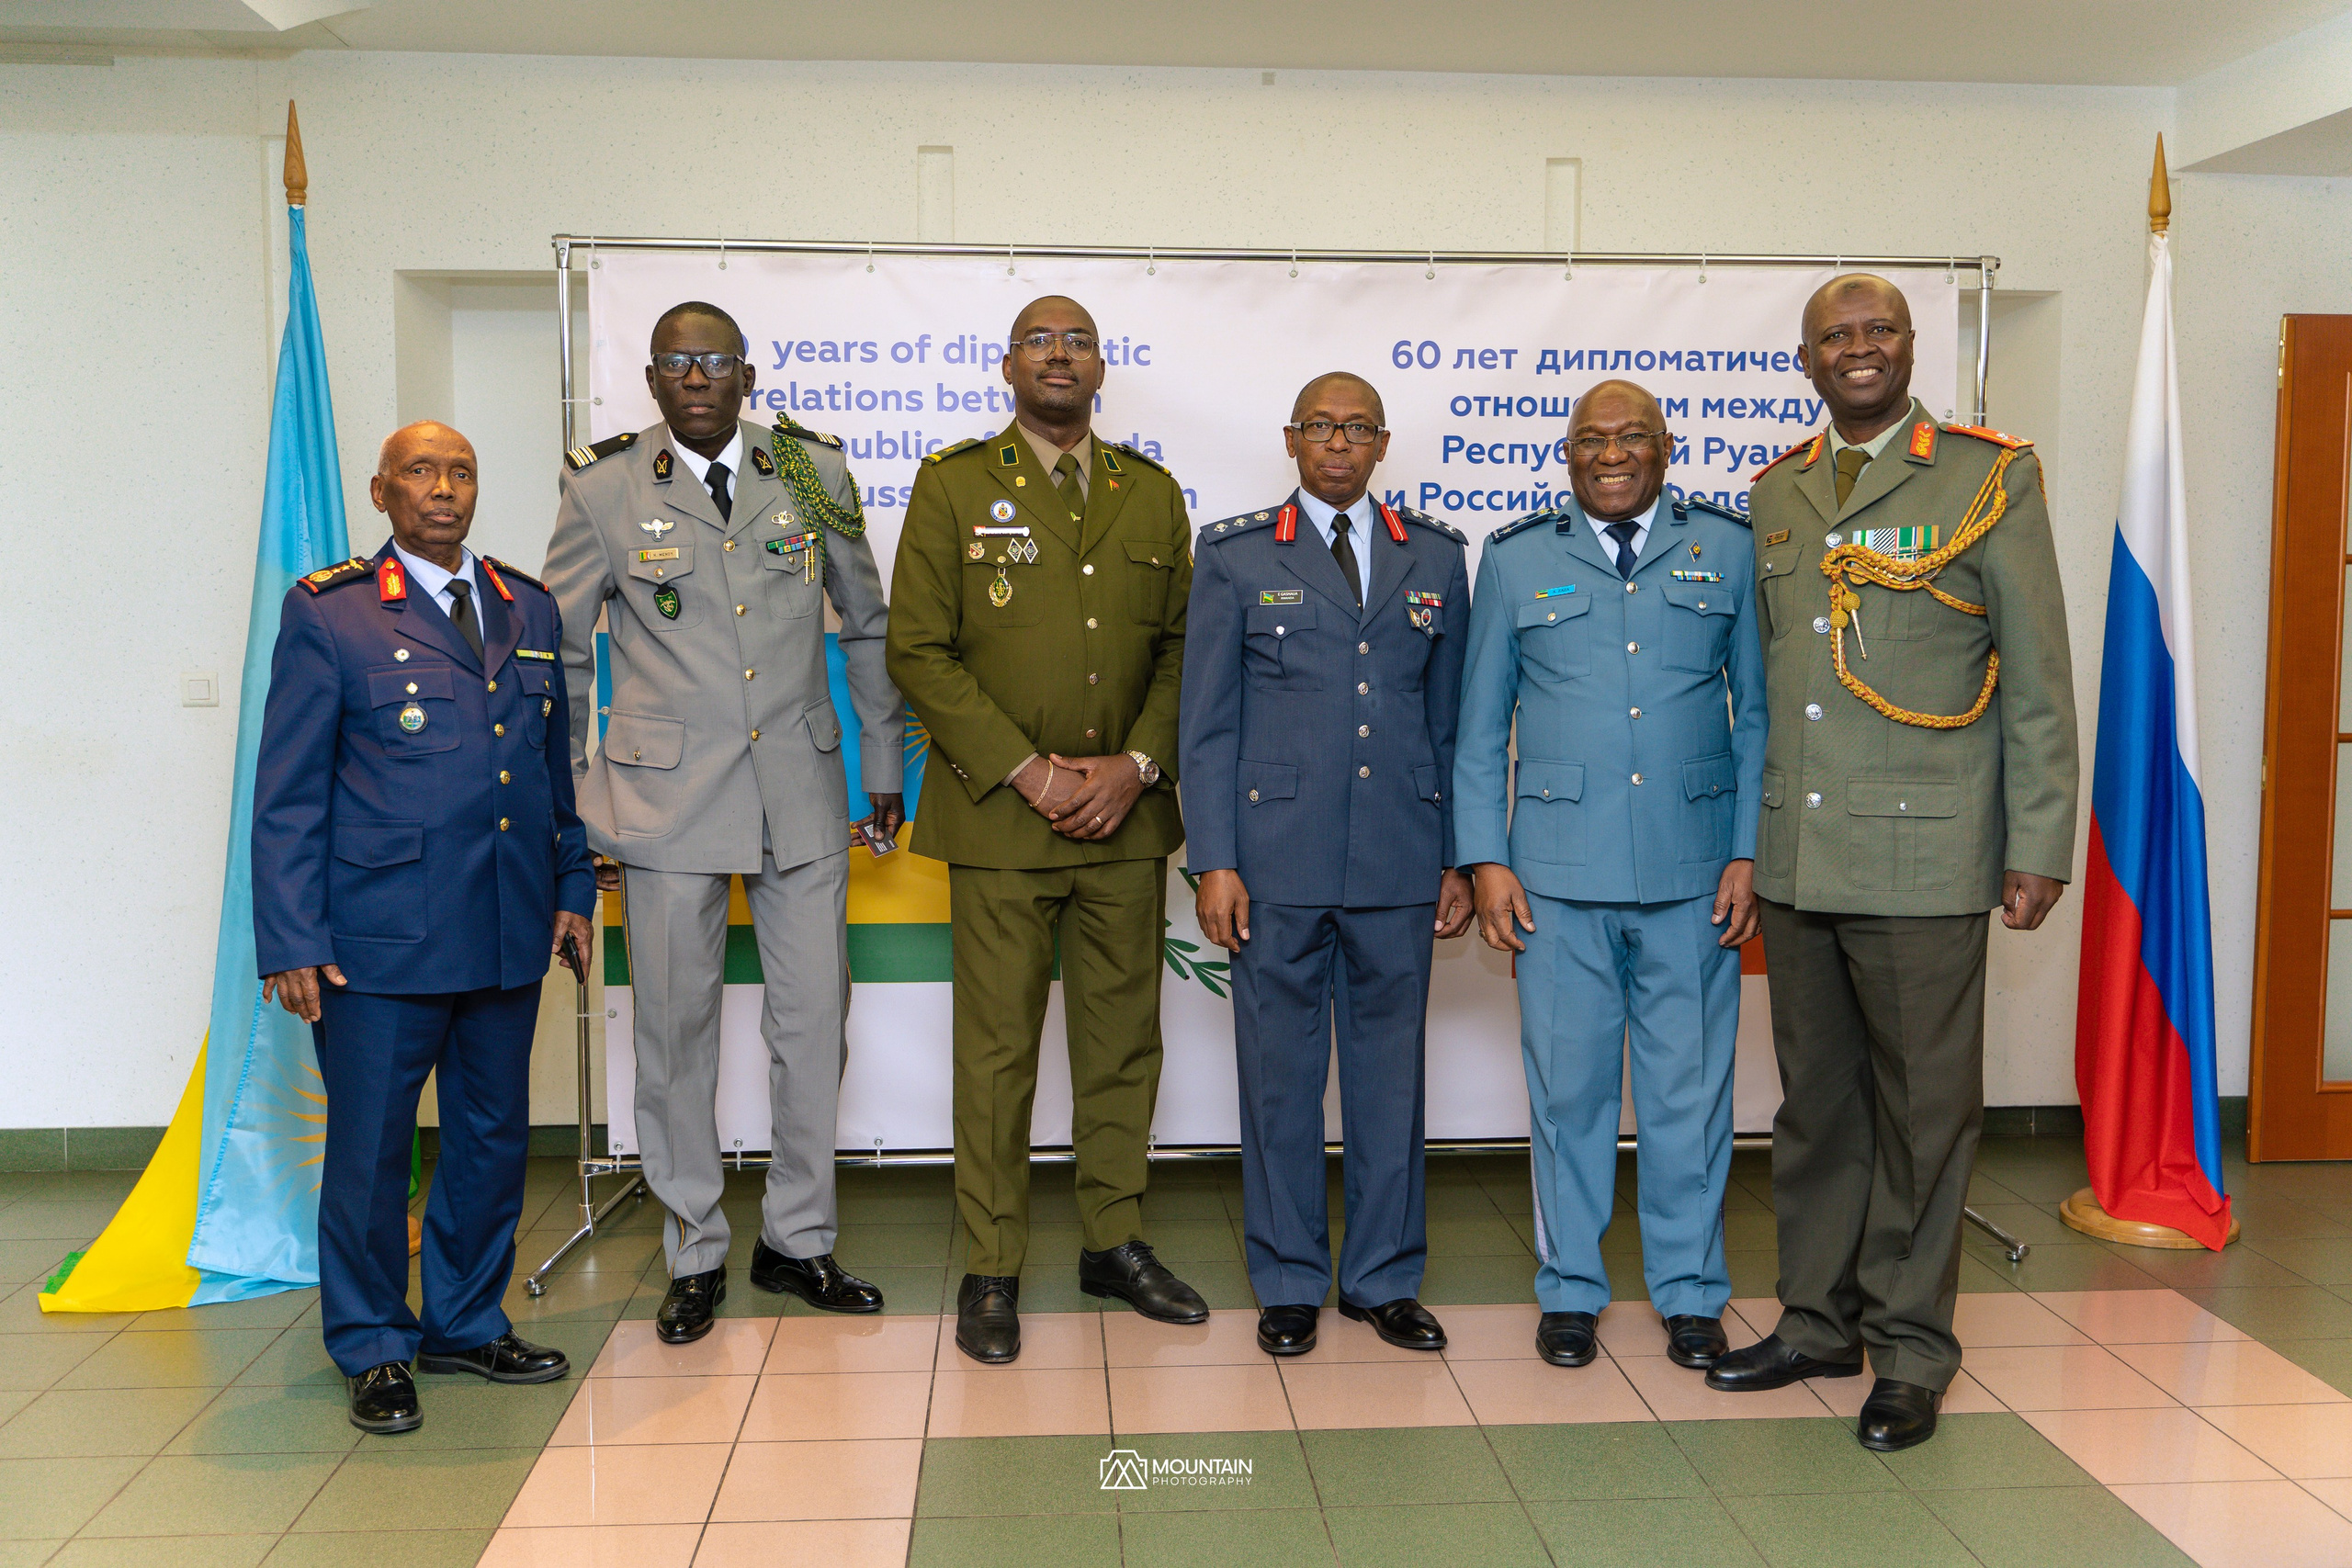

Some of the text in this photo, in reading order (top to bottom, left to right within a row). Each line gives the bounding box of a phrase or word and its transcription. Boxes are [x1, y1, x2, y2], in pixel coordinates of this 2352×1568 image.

[772, 340, 878, 370] years
[890, 334, 932, 364] of
[1392, 340, 1441, 369] 60
[1453, 348, 1518, 369] лет
[750, 381, 923, 412] relations
[1702, 398, 1826, 427] между
[1385, 490, 1406, 511] и
